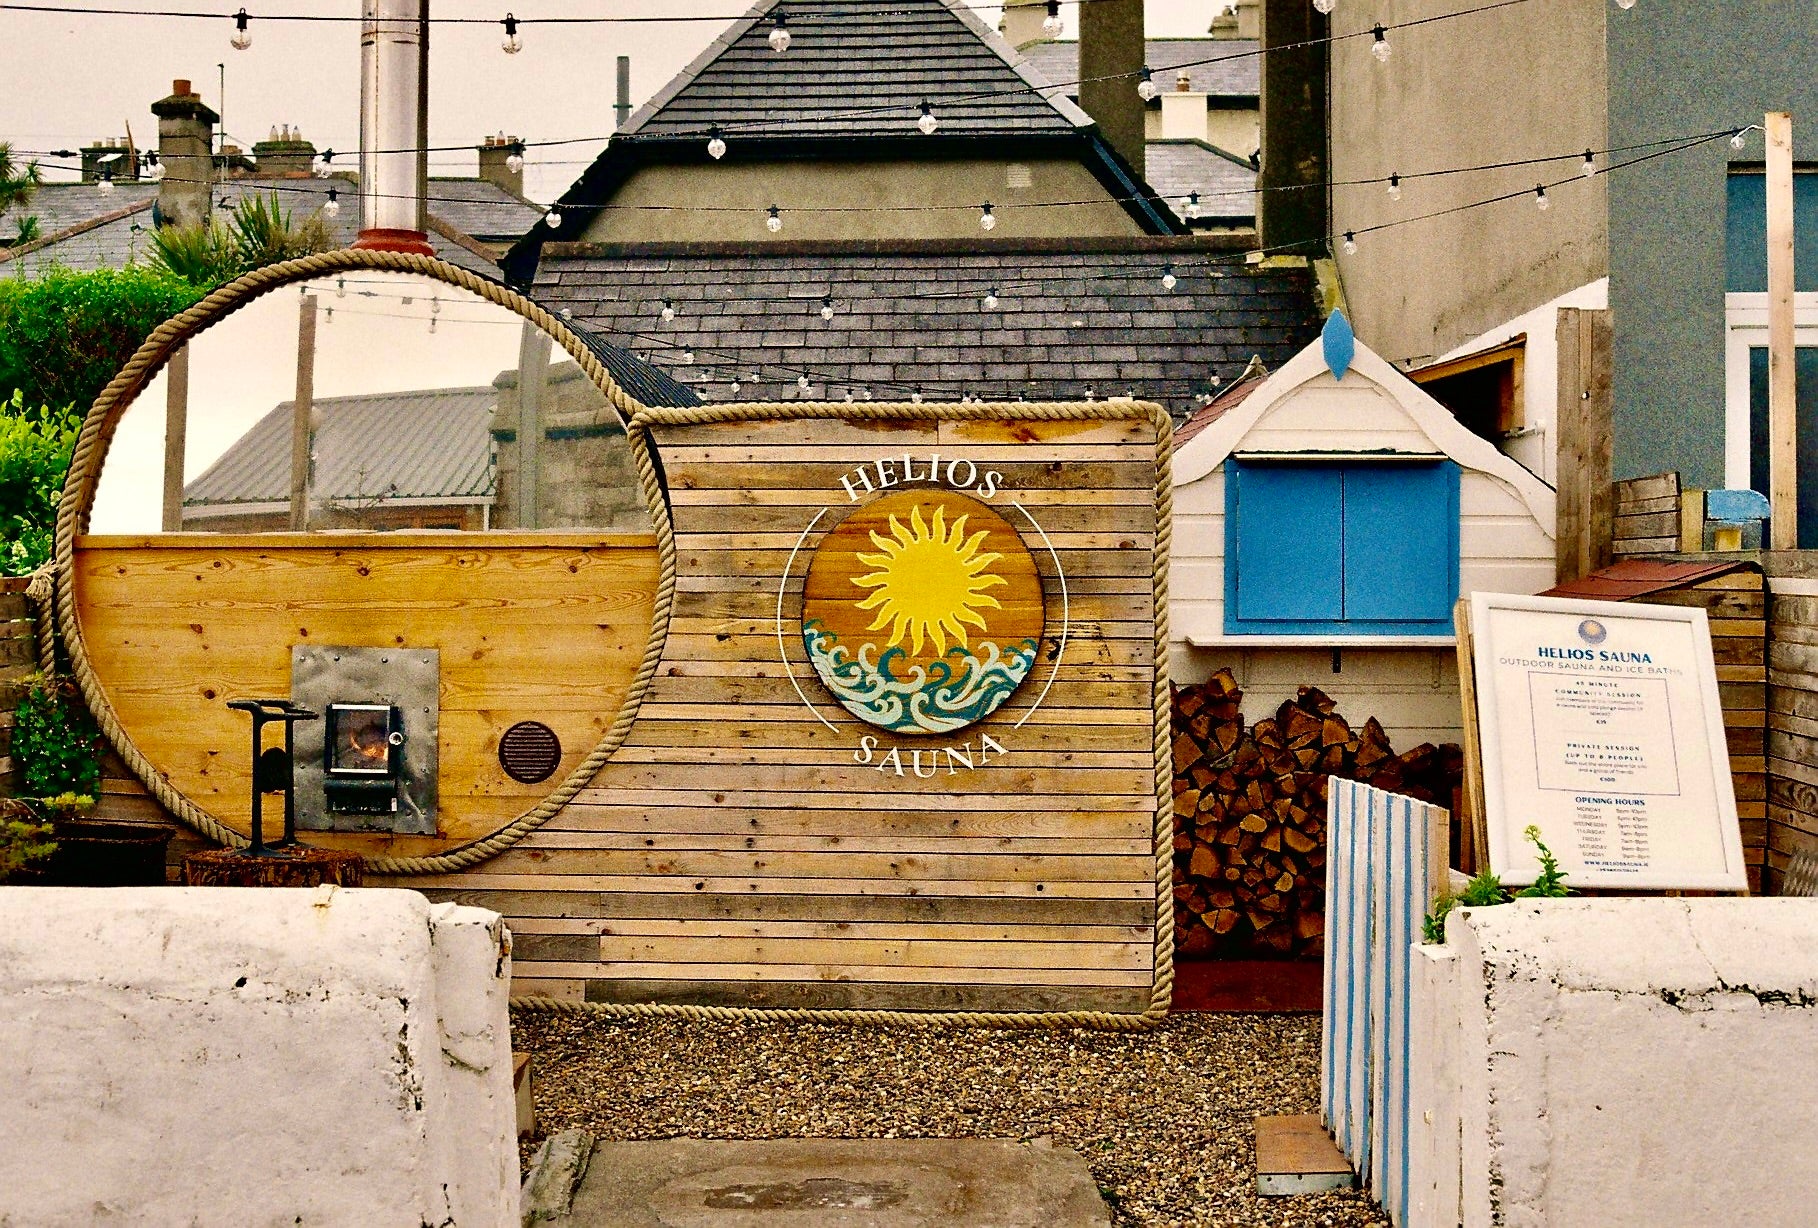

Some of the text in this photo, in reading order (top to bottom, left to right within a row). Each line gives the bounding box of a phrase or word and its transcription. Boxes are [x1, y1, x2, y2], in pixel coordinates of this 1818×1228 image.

[838, 453, 1003, 503] HELIOS
[1538, 647, 1652, 663] HELIOS SAUNA
[1499, 657, 1554, 669] OUTDOOR
[1558, 662, 1595, 670] SAUNA
[1599, 664, 1622, 672] AND
[1627, 666, 1643, 674] ICE
[853, 732, 1009, 779] SAUNA
[1575, 796, 1613, 804] OPENING
